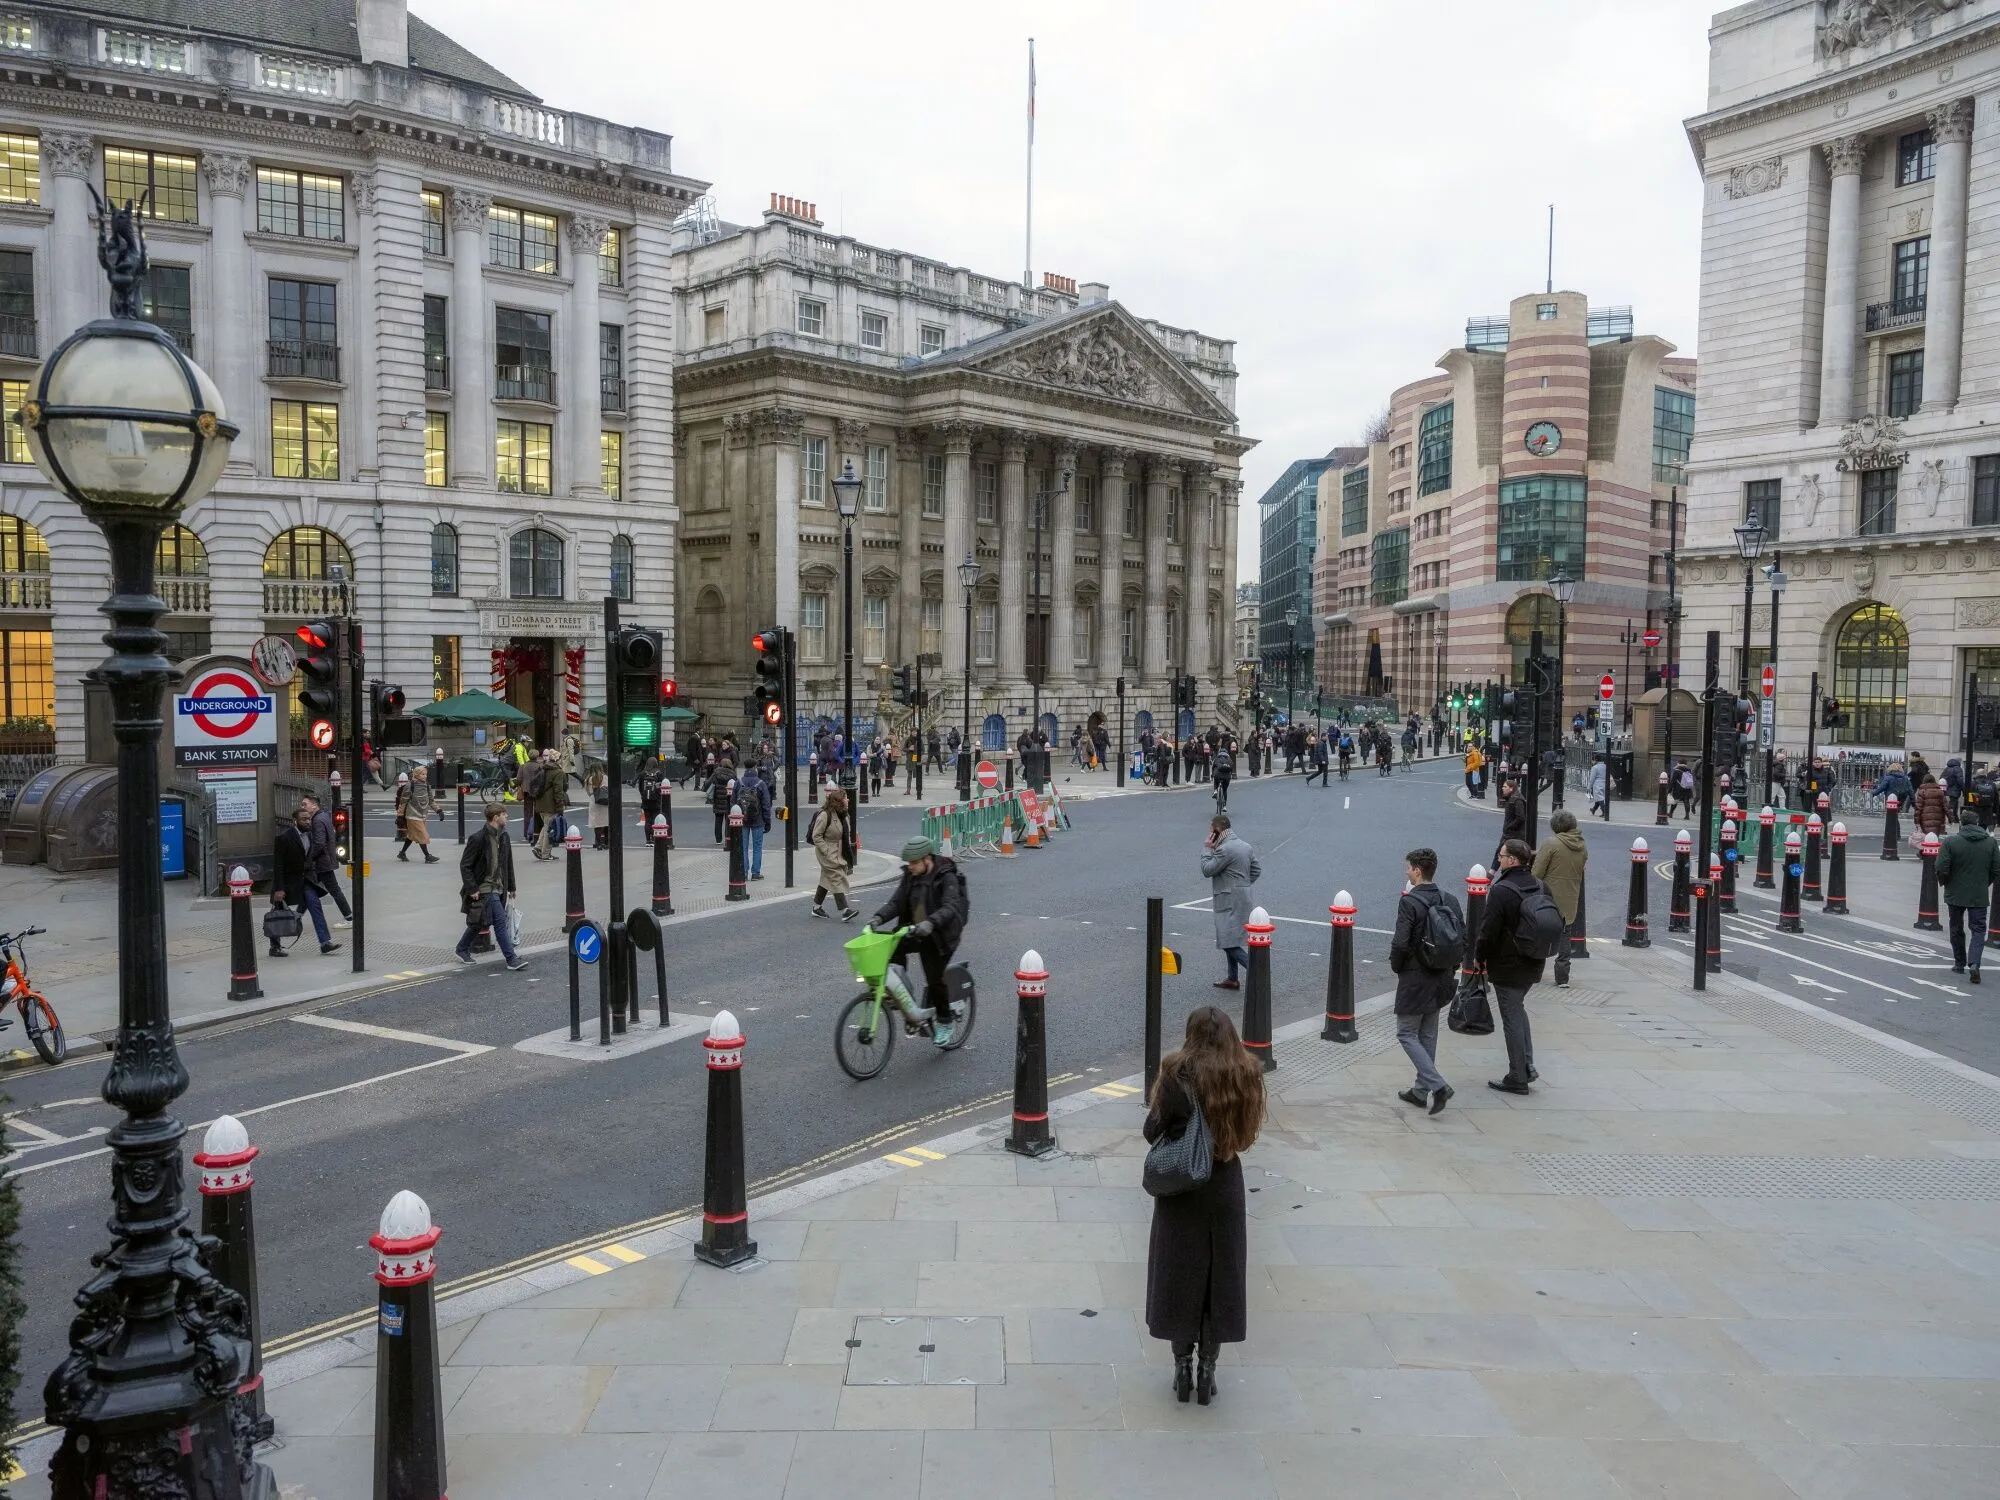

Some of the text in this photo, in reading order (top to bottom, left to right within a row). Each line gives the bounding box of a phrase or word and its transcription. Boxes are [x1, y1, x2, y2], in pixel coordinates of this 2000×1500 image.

[1853, 450, 1910, 470] NatWest
[511, 616, 551, 624] LOMBARD
[554, 617, 582, 625] STREET
[183, 700, 267, 712] UNDERGROUND
[185, 749, 268, 761] BANK STATION
[1848, 750, 1883, 760] NatWest
